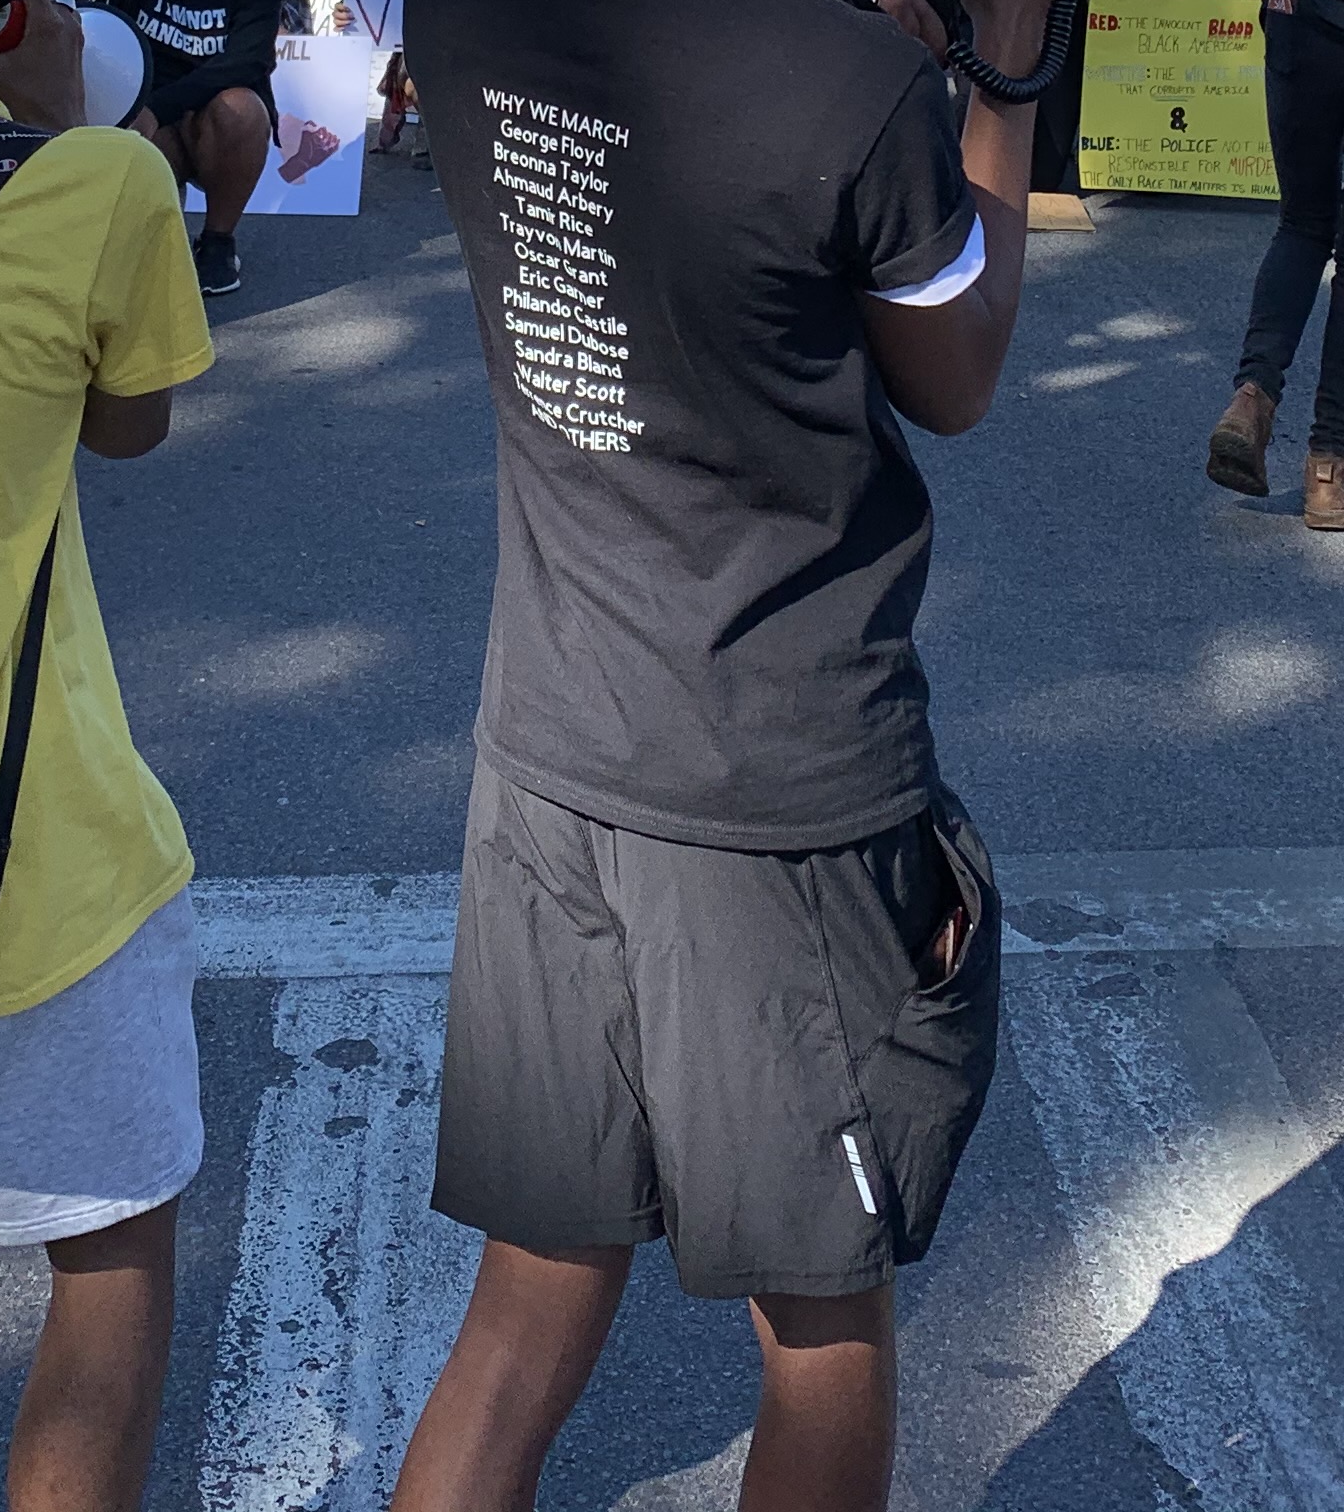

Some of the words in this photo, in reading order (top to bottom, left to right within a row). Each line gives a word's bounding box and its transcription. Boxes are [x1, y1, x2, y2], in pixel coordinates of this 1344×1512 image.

[187, 6, 226, 30] NOT
[1089, 13, 1121, 31] RED:
[1124, 17, 1152, 30] THE
[1152, 17, 1203, 31] INNOCENT
[1208, 18, 1254, 39] BLOOD
[1138, 34, 1180, 55] BLACK
[1119, 84, 1145, 96] THAT
[1203, 85, 1251, 96] AMERICA
[1154, 67, 1176, 81] THE
[482, 87, 525, 115] WHY
[529, 100, 560, 126] WE
[561, 109, 629, 148] MARCH
[1169, 106, 1188, 133] &
[500, 119, 558, 154] George
[561, 135, 605, 168] Floyd
[1081, 136, 1120, 151] BLUE:
[1126, 138, 1153, 152] THE
[1160, 138, 1218, 153] POLICE
[1221, 139, 1251, 153] NOT
[493, 141, 557, 177] Breonna
[560, 161, 610, 194] Taylor
[1082, 170, 1104, 187] THE
[1107, 174, 1133, 188] ONLY
[1137, 175, 1165, 189] RACE
[1108, 154, 1190, 173] RESPONSIBLE
[1198, 157, 1221, 172] FOR
[1227, 156, 1275, 177] MURDE
[493, 166, 554, 202] Ahmaud
[557, 187, 614, 225] Arbery
[515, 195, 556, 226] Tamir
[559, 211, 594, 237] Rice
[499, 211, 562, 252] Trayvon
[563, 236, 618, 270] Martin
[514, 241, 561, 271] Oscar
[563, 259, 608, 287] Grant
[519, 265, 551, 290] Eric
[503, 286, 571, 318] Philando
[574, 306, 628, 336] Castile
[505, 312, 565, 342] Samuel
[568, 325, 629, 360] Dubose
[514, 340, 574, 369] Sandra
[577, 351, 623, 379] Bland
[516, 360, 571, 394] Walter
[575, 377, 626, 405] Scott
[566, 403, 645, 435] Crutcher
